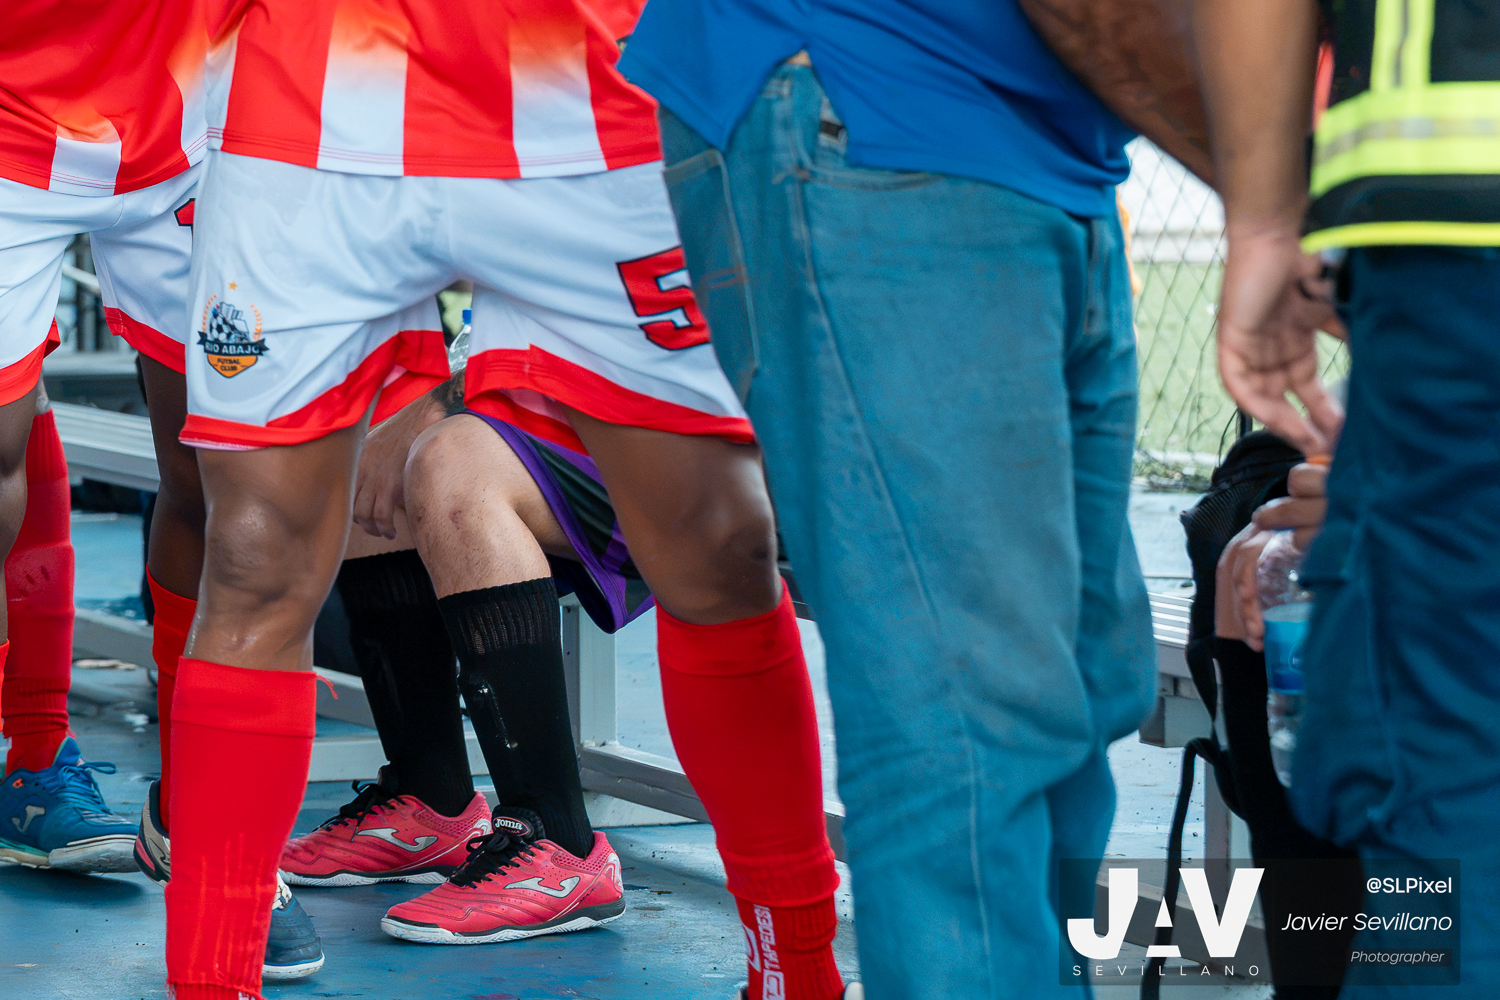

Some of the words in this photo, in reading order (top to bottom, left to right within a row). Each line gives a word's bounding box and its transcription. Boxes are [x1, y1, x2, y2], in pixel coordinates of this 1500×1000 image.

[615, 245, 712, 351] 5
[222, 345, 260, 354] ABAJO
[495, 818, 523, 831] Joma
